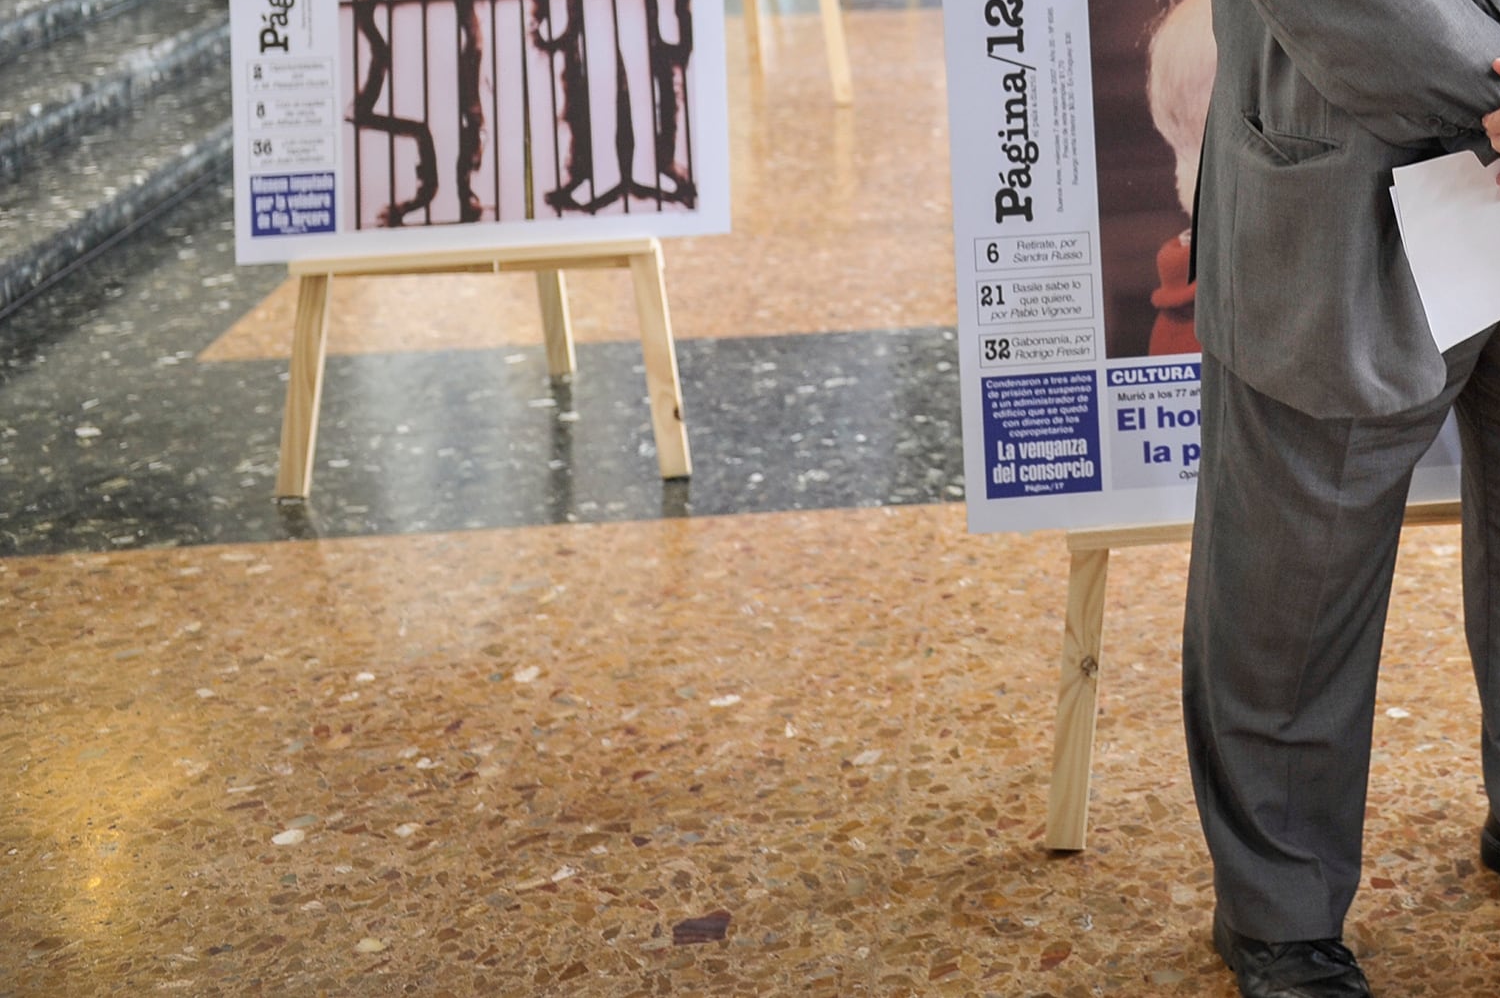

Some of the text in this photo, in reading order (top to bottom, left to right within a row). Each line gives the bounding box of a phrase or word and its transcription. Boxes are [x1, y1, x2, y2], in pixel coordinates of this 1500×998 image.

[1060, 239, 1077, 249] por
[986, 242, 1000, 264] 6
[1012, 250, 1083, 263] Sandra Russo
[1012, 280, 1081, 293] Basile sabe lo
[980, 284, 1006, 307] 21
[1019, 296, 1039, 306] que
[991, 306, 1082, 322] por Pablo Vignone
[1074, 334, 1092, 344] por
[985, 338, 1011, 361] 32
[1015, 349, 1054, 360] Rodrigo
[985, 378, 1042, 389] Condenaron
[1050, 376, 1068, 384] tres
[1070, 374, 1092, 383] años
[1111, 365, 1196, 384] CULTURA
[987, 385, 1092, 399] de prisión en suspenso
[1117, 390, 1146, 402] Murió
[1157, 389, 1173, 399] los
[1175, 388, 1187, 398] 77
[991, 395, 1089, 409] a un administrador de
[992, 404, 1089, 419] edificio que se quedó
[1117, 406, 1147, 432] El
[1002, 415, 1080, 428] con dinero de los
[997, 438, 1088, 461] La venganza
[1143, 440, 1172, 464] la
[993, 457, 1095, 484] del consorcio
